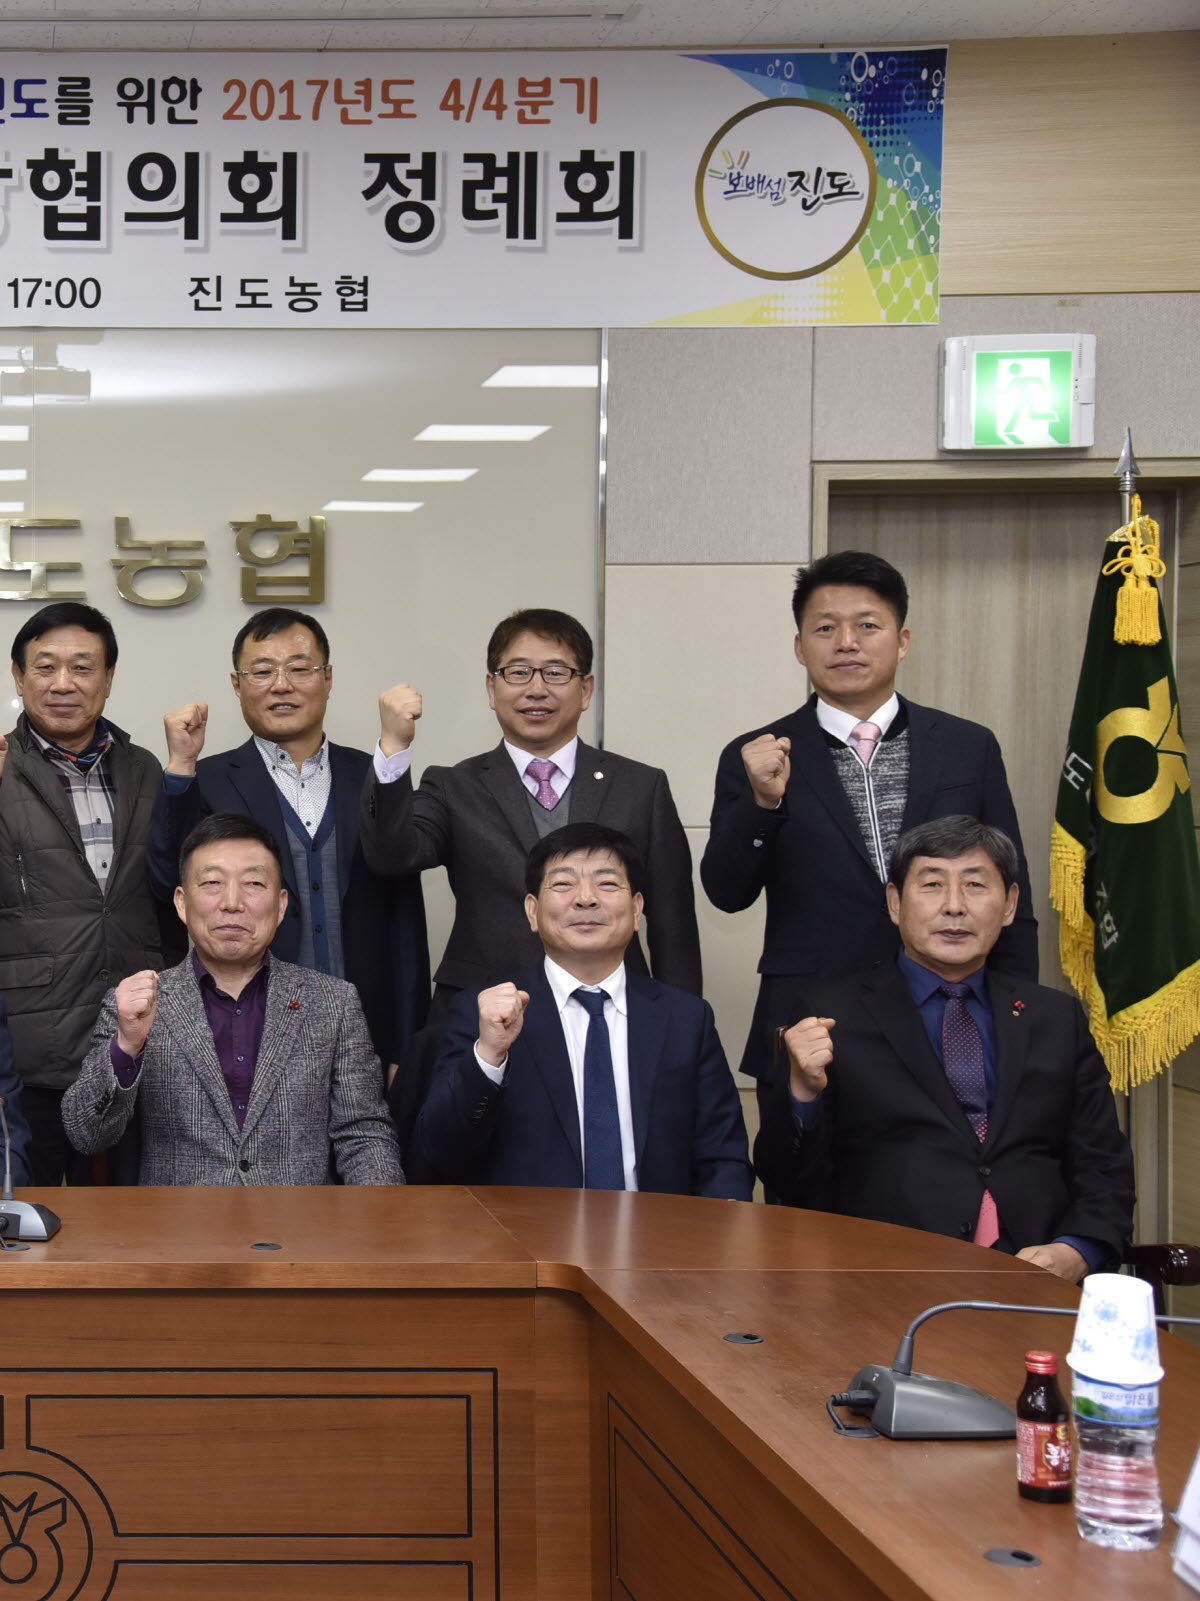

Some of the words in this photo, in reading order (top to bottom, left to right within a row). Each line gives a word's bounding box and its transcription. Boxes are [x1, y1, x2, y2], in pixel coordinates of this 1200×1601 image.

[117, 77, 204, 127] 위한
[224, 78, 418, 125] 2017년도
[441, 77, 600, 126] 4/4분기
[362, 149, 636, 245] 정례회
[723, 171, 782, 201] 보배섬
[787, 166, 860, 211] 진도
[8, 277, 103, 310] 17:00
[188, 275, 371, 314] 진도농협
